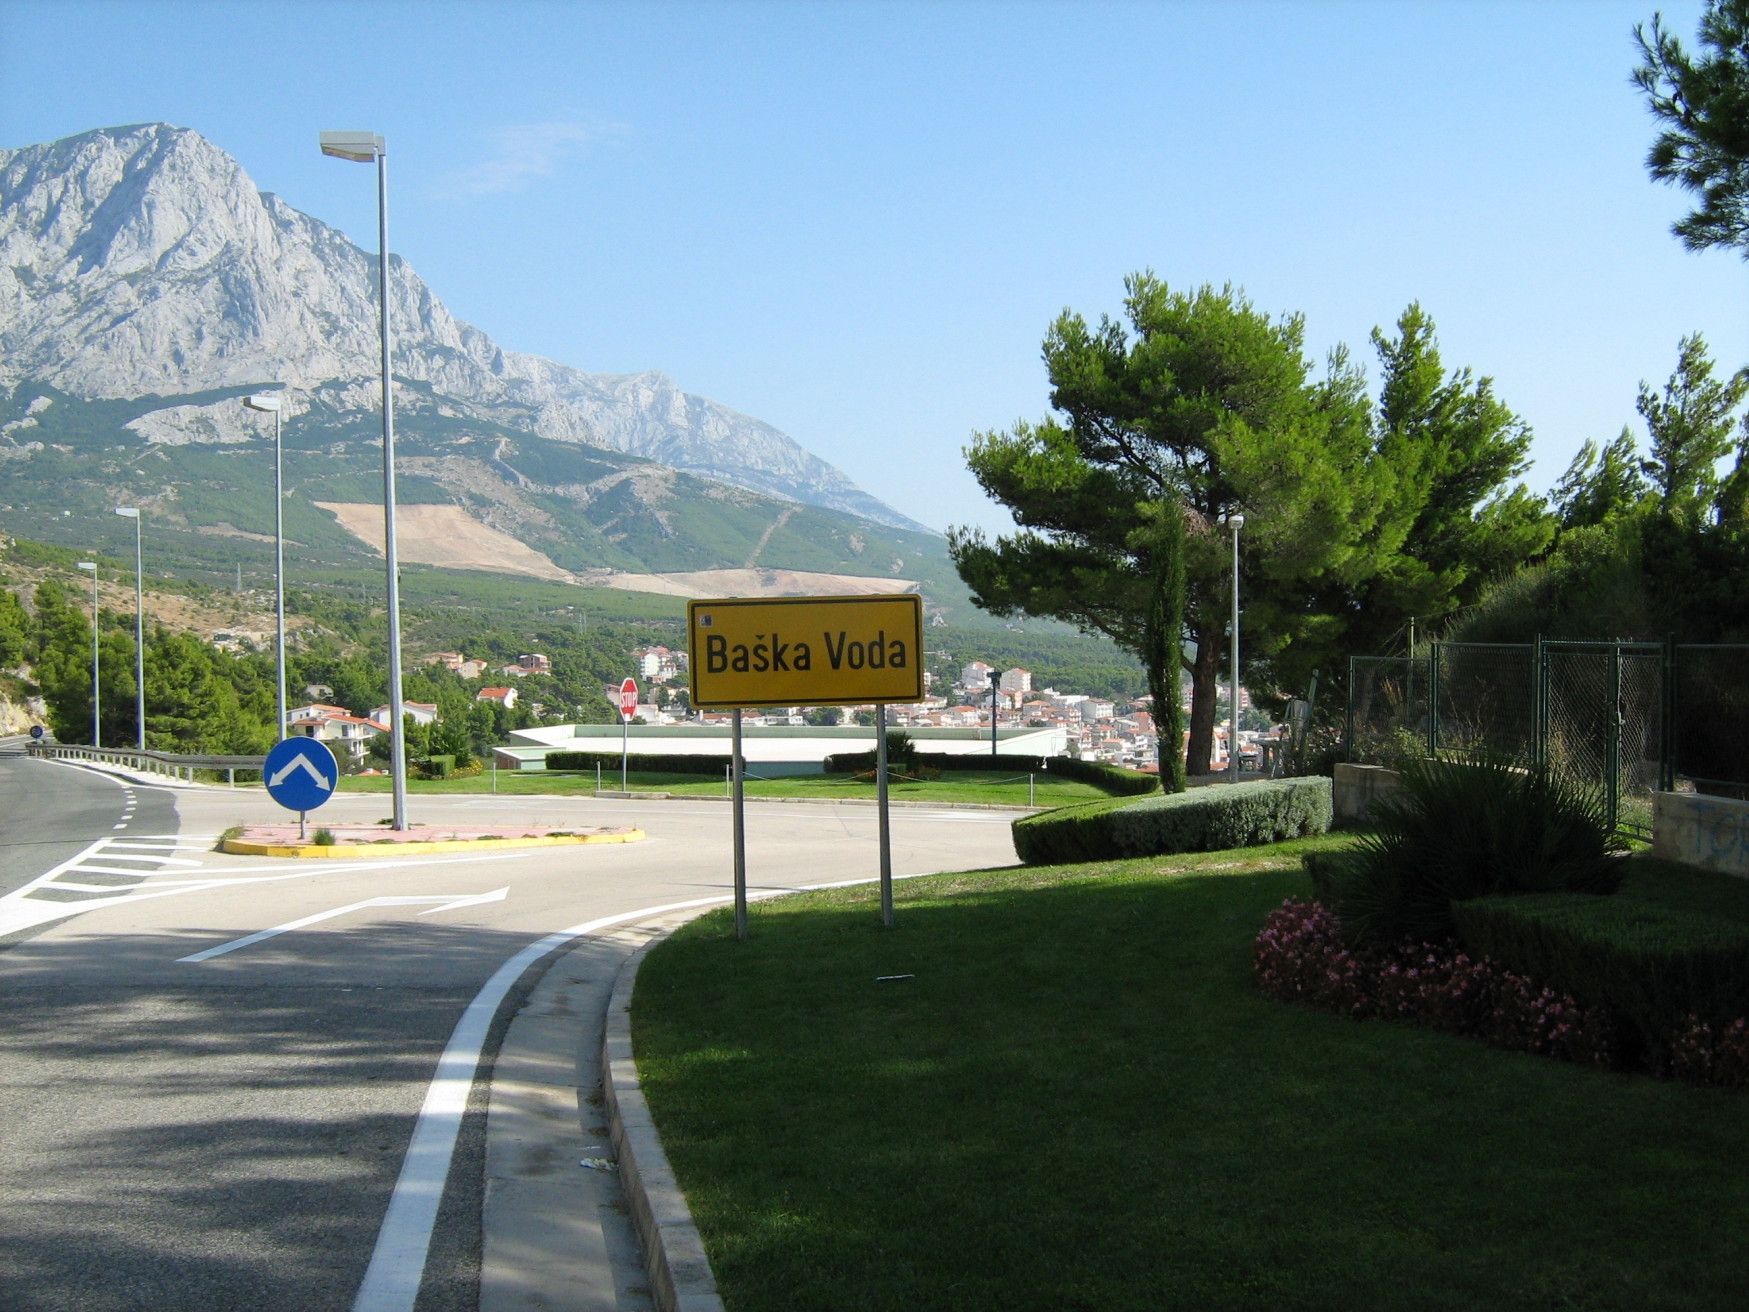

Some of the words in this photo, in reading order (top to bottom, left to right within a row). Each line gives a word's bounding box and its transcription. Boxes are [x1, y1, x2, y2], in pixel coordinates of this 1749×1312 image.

[706, 633, 811, 673] Baška
[823, 630, 906, 670] Voda
[620, 691, 636, 708] STOP
